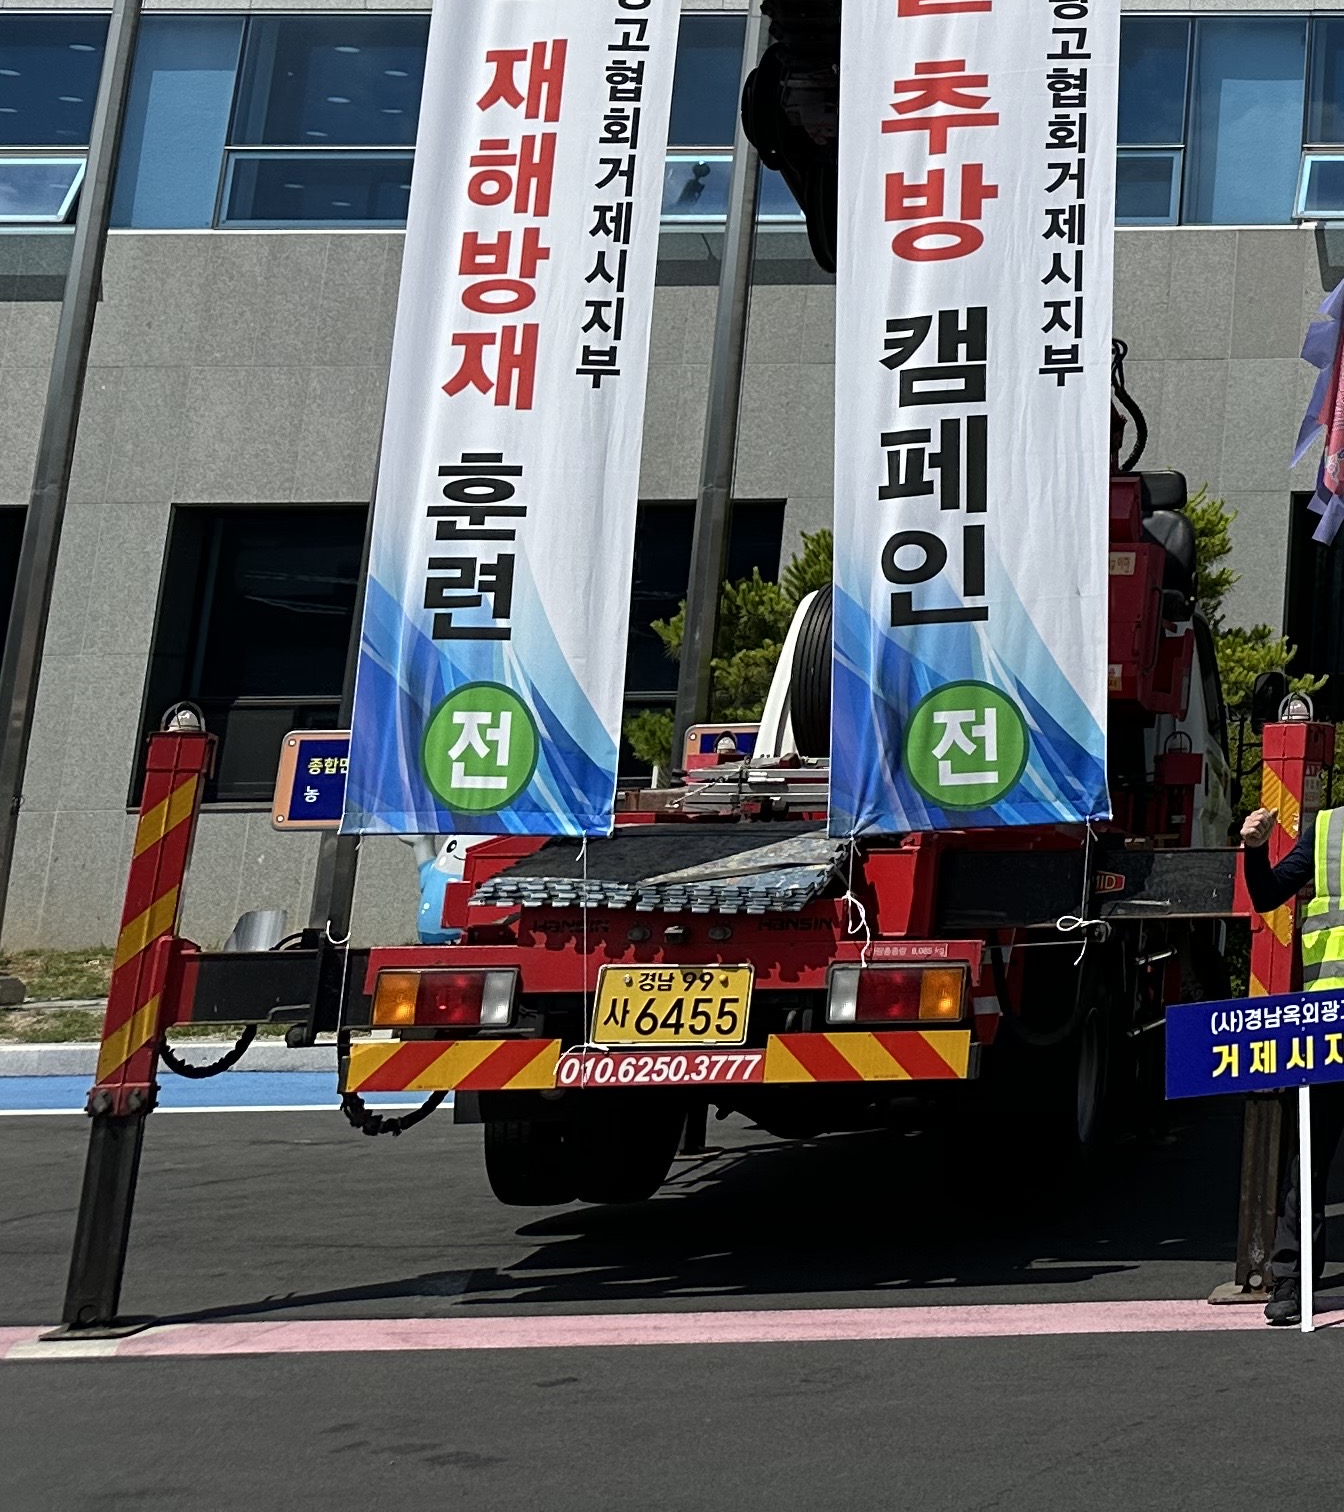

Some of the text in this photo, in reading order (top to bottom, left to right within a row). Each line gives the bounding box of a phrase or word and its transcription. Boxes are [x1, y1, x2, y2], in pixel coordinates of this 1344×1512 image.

[883, 61, 997, 261] 추방
[442, 38, 569, 410] 재해방재
[879, 307, 988, 627] 캠페인
[424, 453, 526, 640] 훈련
[448, 712, 512, 789] 전
[932, 708, 998, 785] 전
[602, 997, 739, 1036] 사 6455
[638, 971, 715, 992] 경남 99
[560, 1054, 762, 1085] 010.6250.3777
